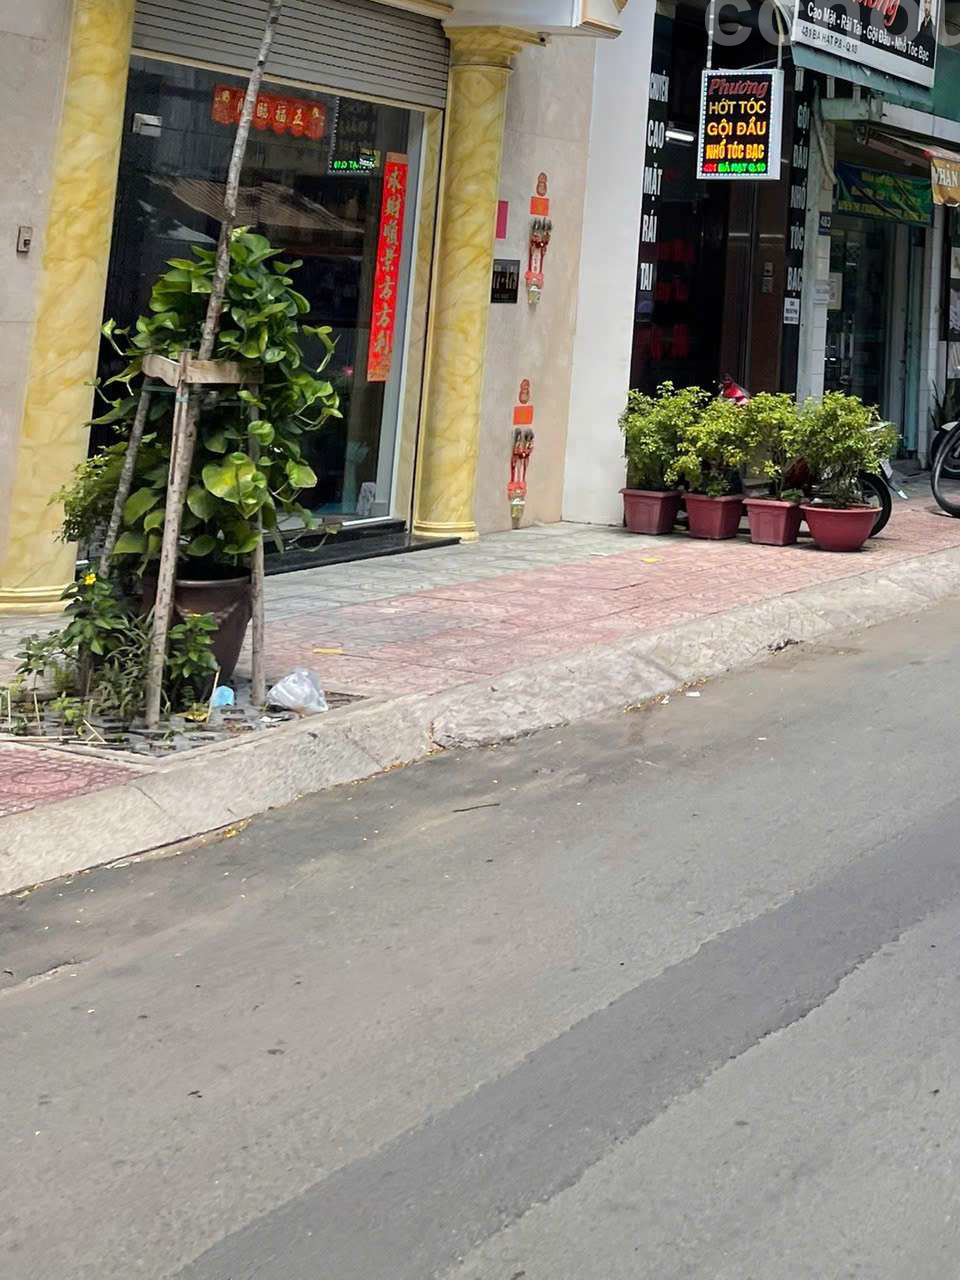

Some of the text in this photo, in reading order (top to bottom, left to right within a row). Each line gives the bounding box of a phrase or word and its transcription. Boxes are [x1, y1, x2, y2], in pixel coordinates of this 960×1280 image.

[807, 2, 823, 22] Cạo
[907, 41, 919, 57] Tóc
[708, 78, 769, 98] Phương
[709, 97, 766, 114] HỚT TÓC
[647, 119, 665, 154] CẠO
[707, 118, 733, 138] GỘI
[727, 141, 745, 159] TÓC
[746, 143, 765, 162] BẠC
[640, 262, 653, 291] TAI
